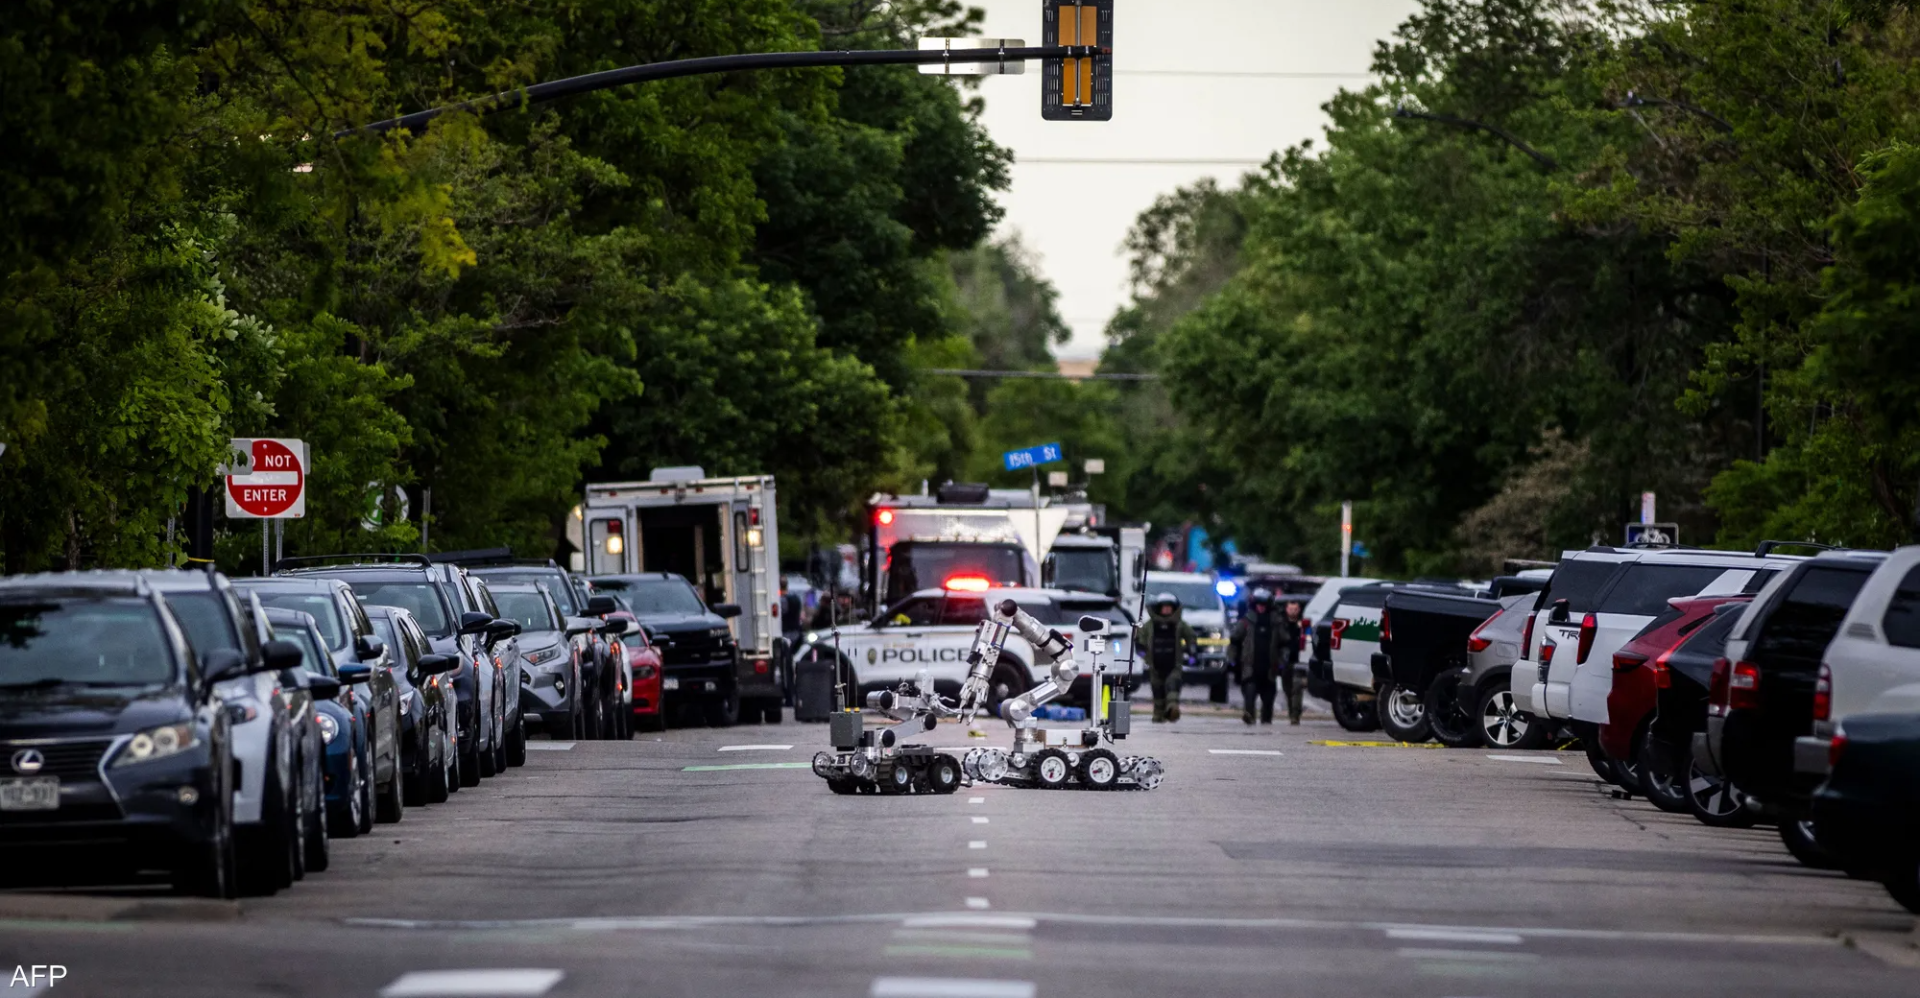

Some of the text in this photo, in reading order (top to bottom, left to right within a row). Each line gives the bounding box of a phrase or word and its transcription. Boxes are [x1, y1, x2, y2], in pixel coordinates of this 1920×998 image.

[265, 455, 291, 467] NOT
[1008, 446, 1057, 468] 15th St
[244, 489, 287, 502] ENTER
[1559, 629, 1580, 640] TR
[882, 648, 970, 663] POLICE
